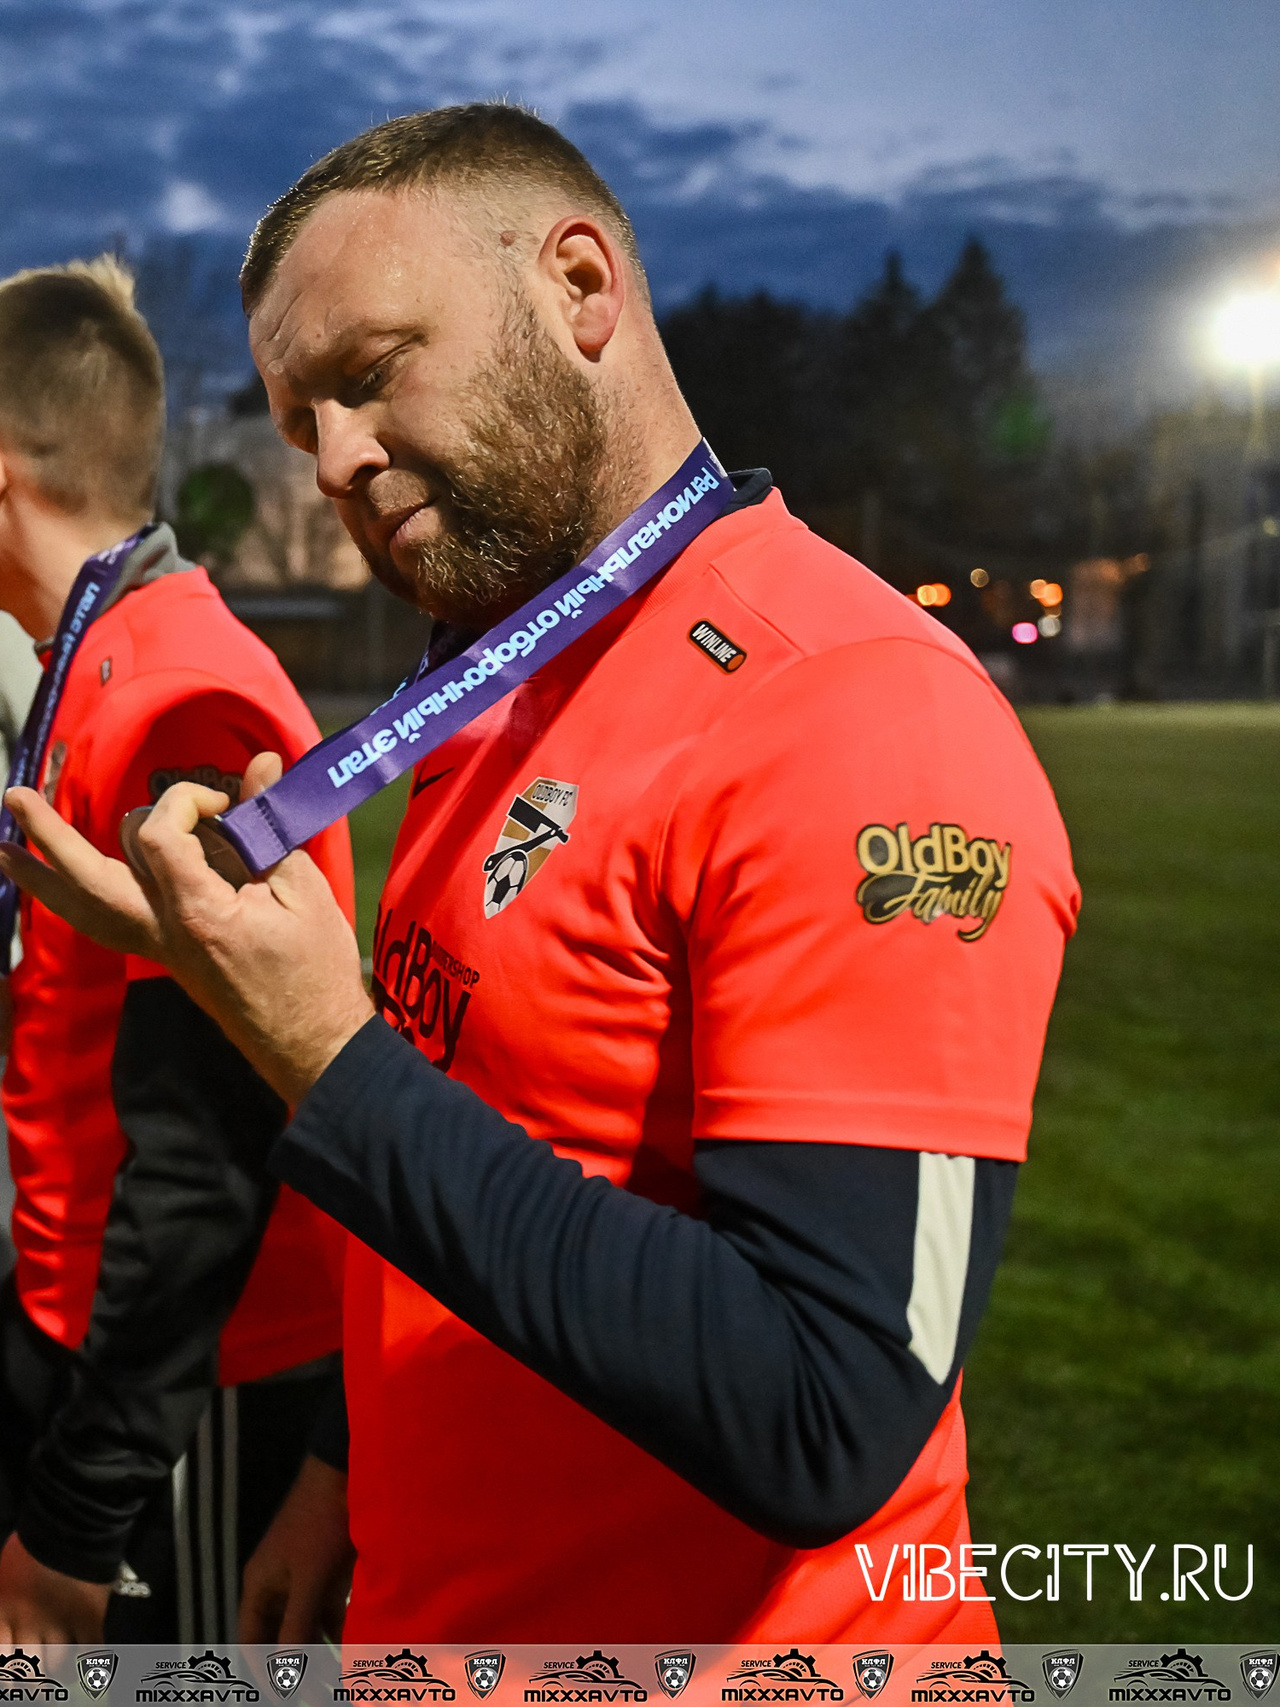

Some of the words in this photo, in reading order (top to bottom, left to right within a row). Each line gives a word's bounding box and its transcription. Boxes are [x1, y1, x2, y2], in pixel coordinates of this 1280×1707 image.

[554, 467, 720, 618] Региональный
[393, 609, 561, 743] отборочный
[692, 623, 738, 665] WINLINE
[327, 729, 398, 788] этап
[531, 783, 565, 804] OLDBOY
[558, 789, 574, 807] FC
[856, 822, 1012, 888] OldBoy
[856, 868, 1007, 943] Family
